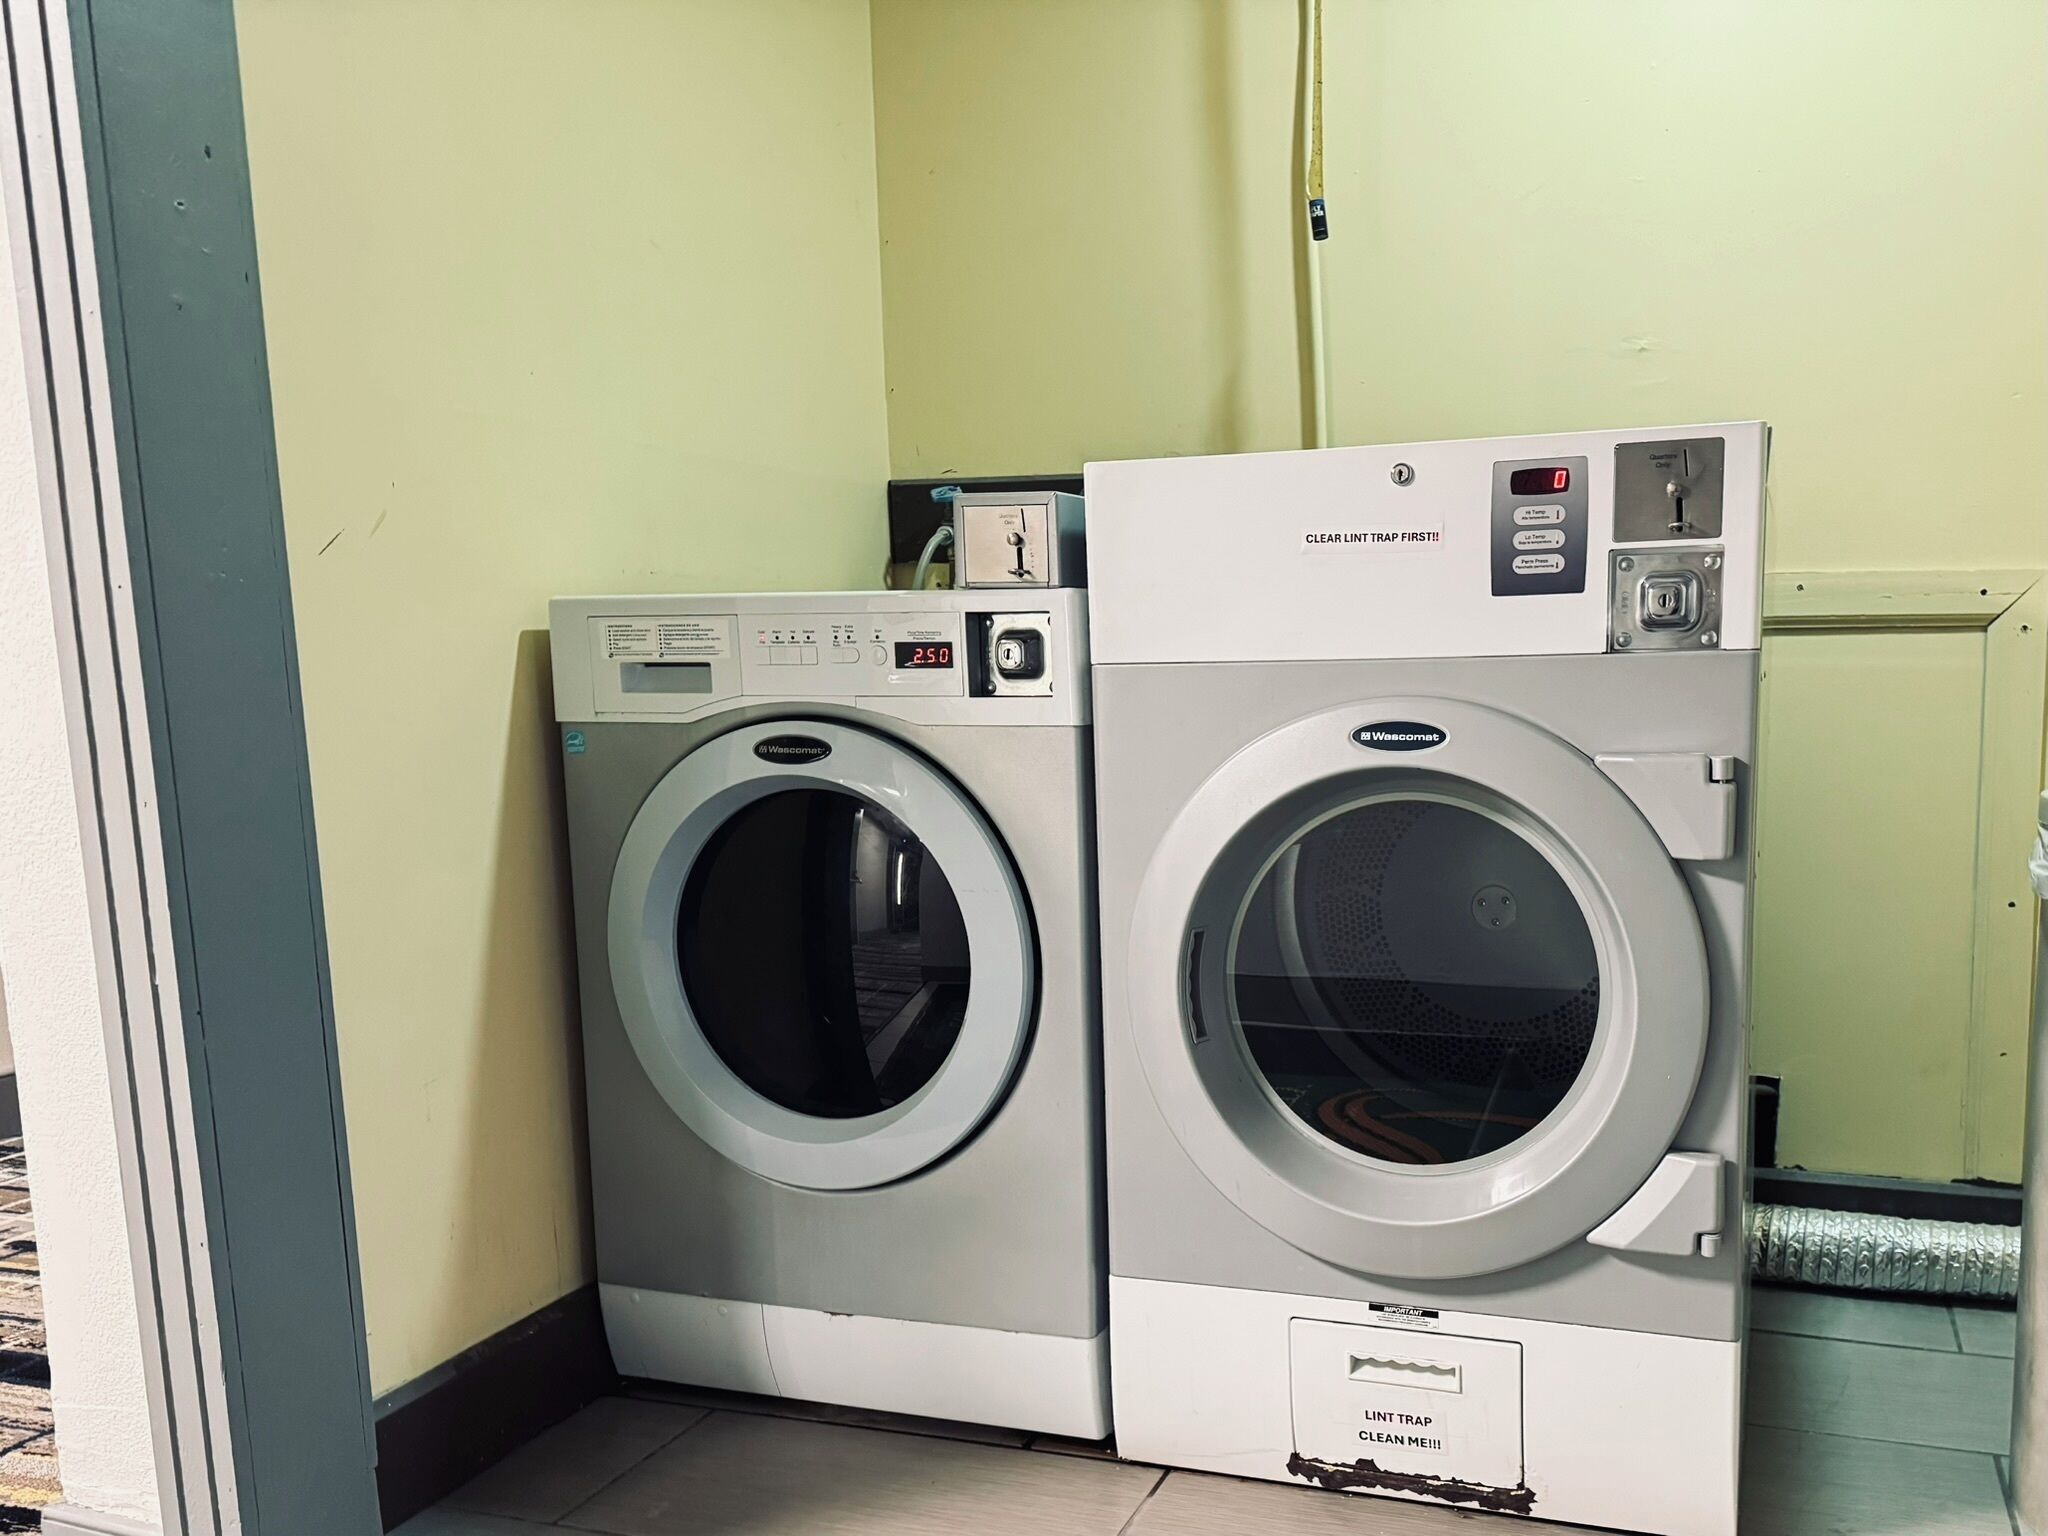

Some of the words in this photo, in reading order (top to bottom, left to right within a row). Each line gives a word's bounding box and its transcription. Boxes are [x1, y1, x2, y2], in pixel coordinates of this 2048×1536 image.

[1553, 470, 1567, 489] 0
[1305, 533, 1342, 544] CLEAR
[1344, 533, 1369, 543] LINT
[1370, 532, 1399, 543] TRAP
[1401, 531, 1440, 542] FIRST!!
[913, 648, 949, 664] 2.50
[1372, 731, 1440, 742] Wascomat
[768, 745, 824, 754] Wascomat
[1383, 1306, 1423, 1316] IMPORTANT
[1365, 1410, 1395, 1423] LINT
[1397, 1413, 1433, 1427] TRAP
[1358, 1430, 1405, 1446] CLEAN
[1407, 1436, 1441, 1450] ME!!!
